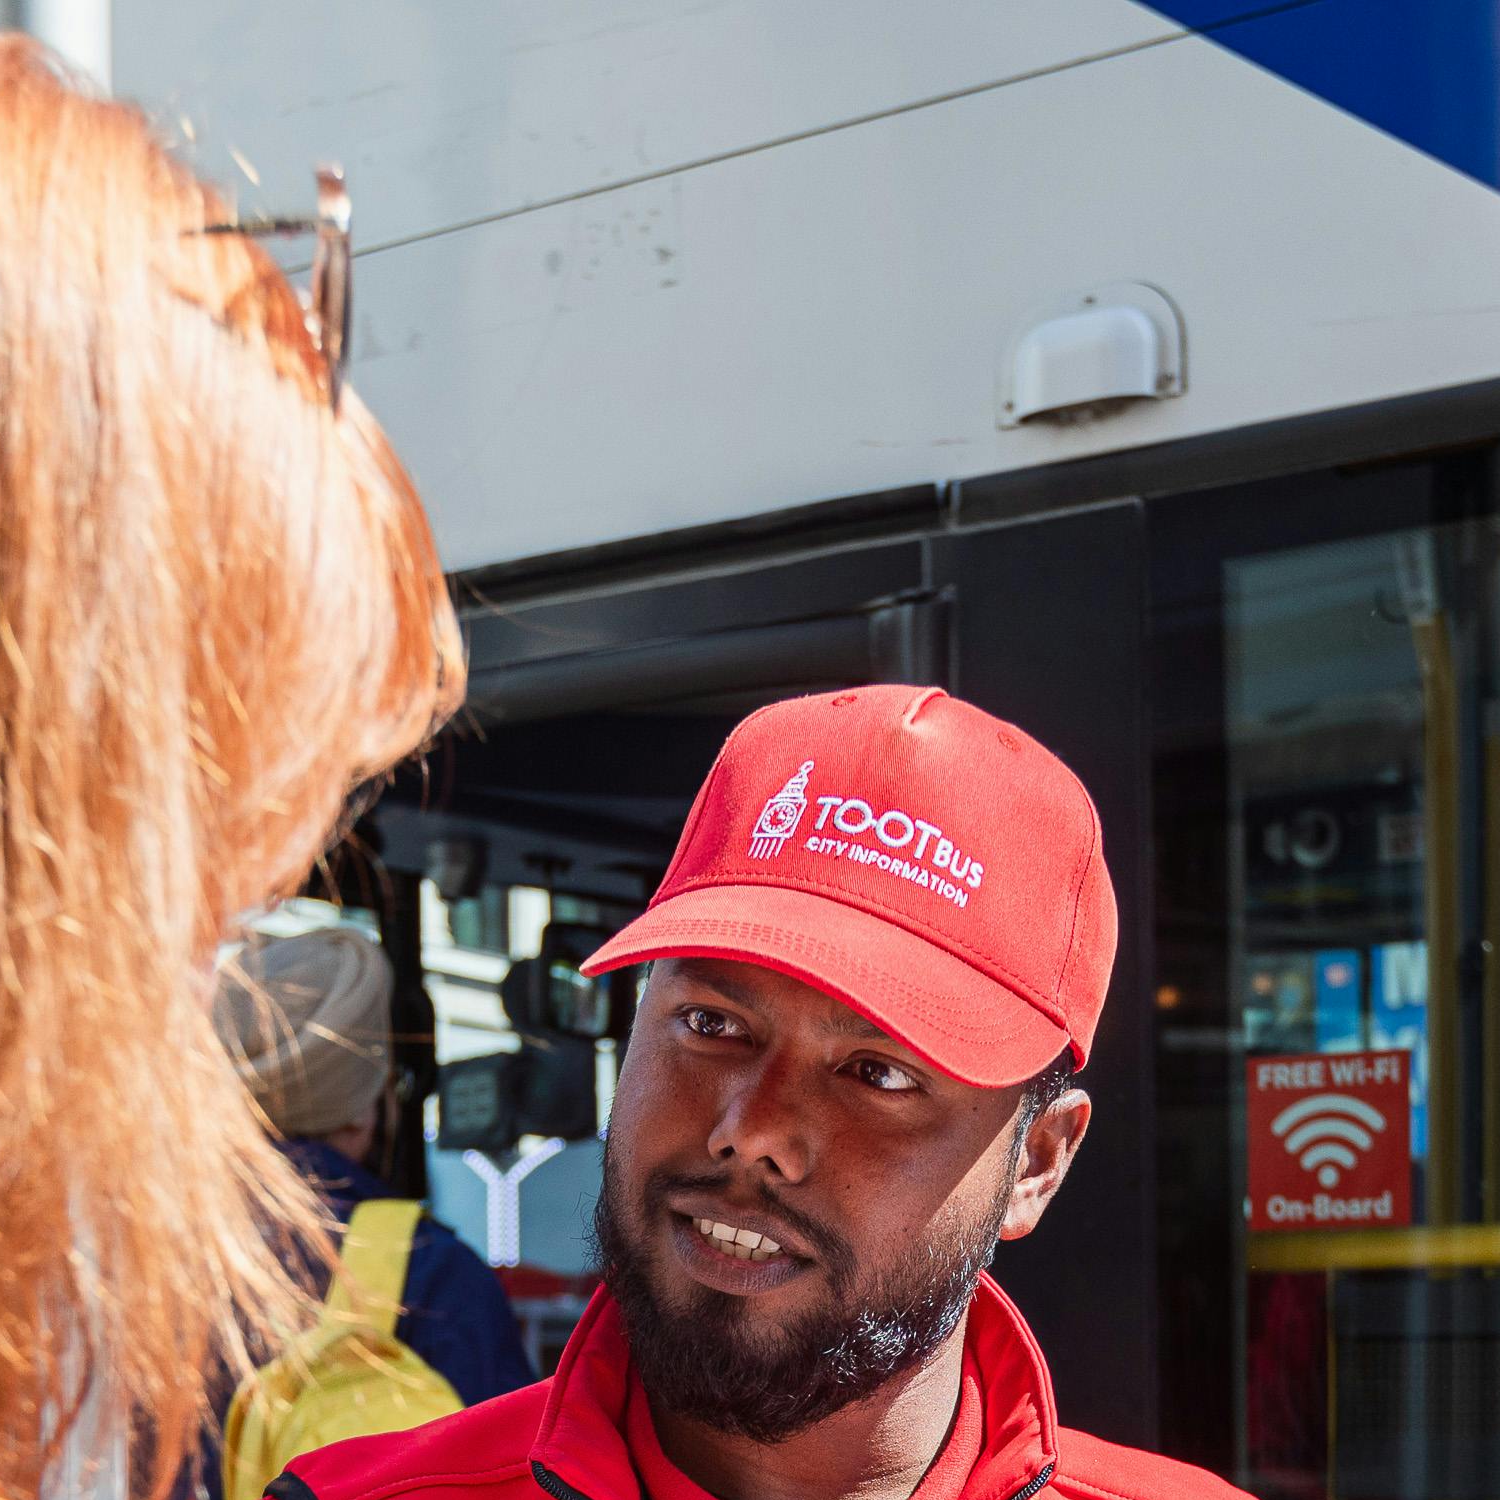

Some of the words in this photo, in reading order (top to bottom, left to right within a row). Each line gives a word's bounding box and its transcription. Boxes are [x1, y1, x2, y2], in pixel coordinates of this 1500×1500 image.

[805, 836, 849, 857] CITY
[848, 844, 969, 909] INFORMATION
[1257, 1061, 1323, 1090] FREE
[1267, 1190, 1392, 1221] On-Board
